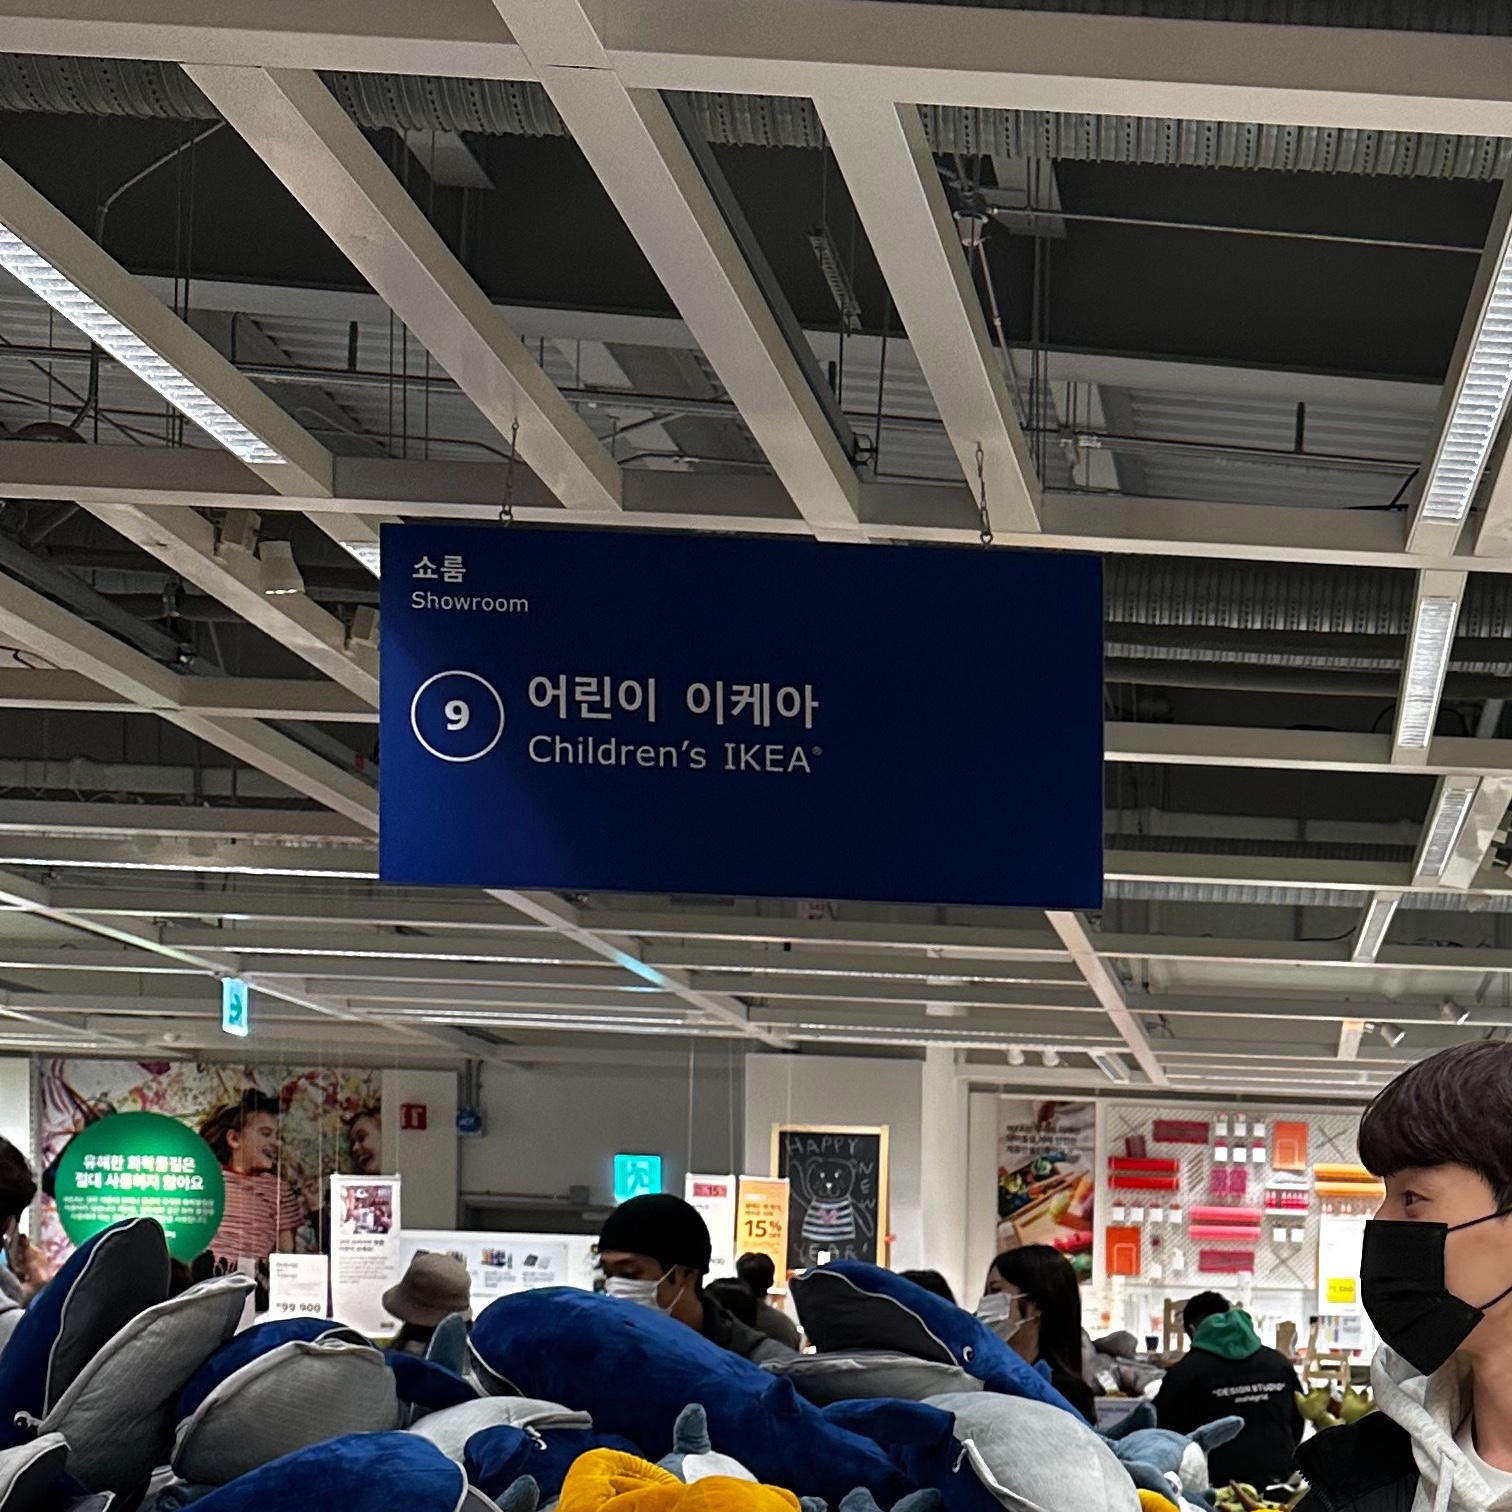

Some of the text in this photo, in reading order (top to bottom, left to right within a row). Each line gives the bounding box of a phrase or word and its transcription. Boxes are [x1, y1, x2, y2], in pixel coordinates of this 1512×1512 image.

[412, 555, 466, 582] 쇼룸
[411, 591, 529, 613] Showroom
[444, 674, 820, 730] 9 어린이 이케아
[528, 735, 707, 769] Children's
[785, 1135, 859, 1155] HAPPY
